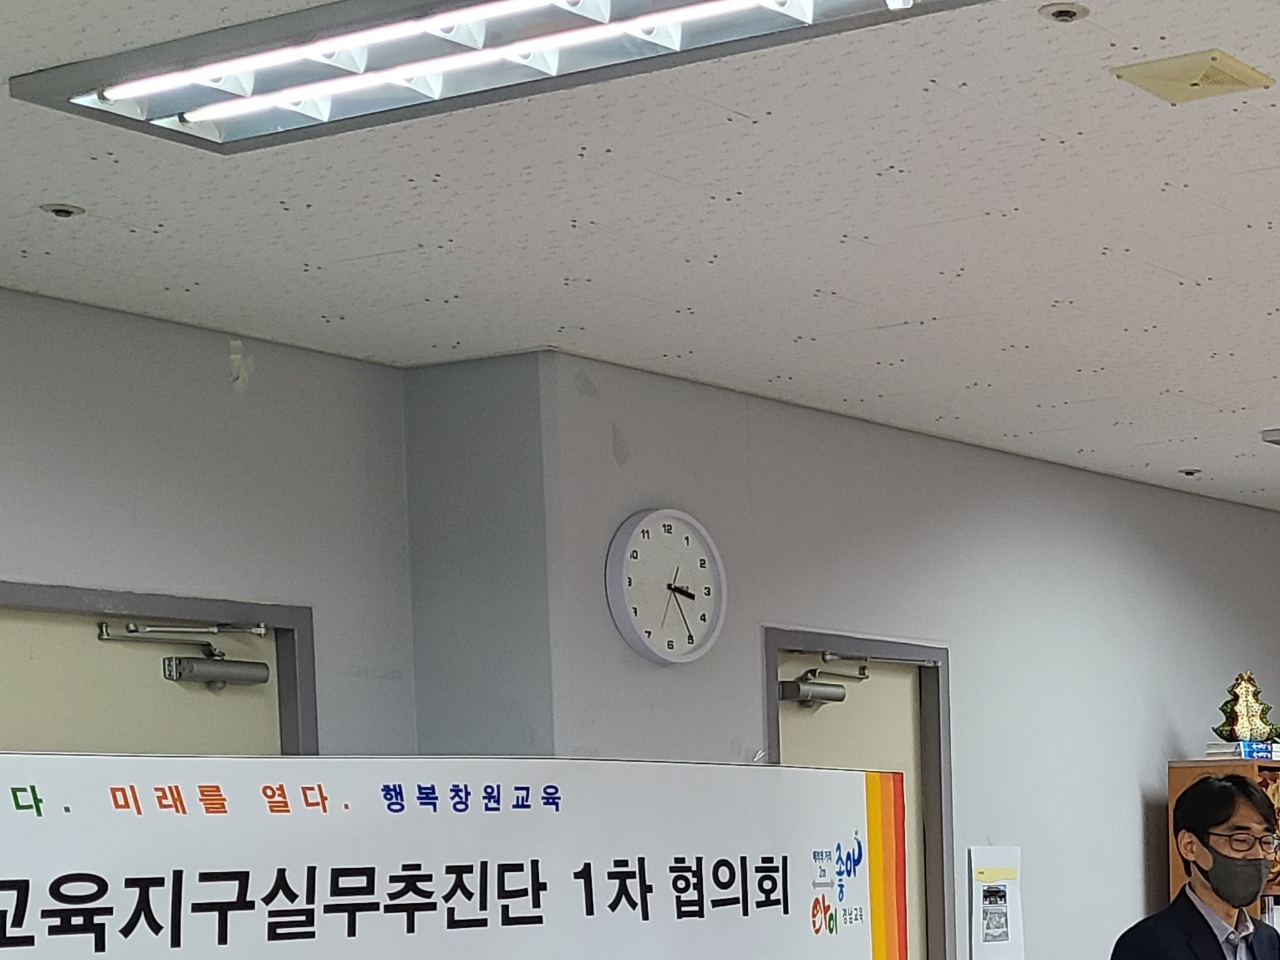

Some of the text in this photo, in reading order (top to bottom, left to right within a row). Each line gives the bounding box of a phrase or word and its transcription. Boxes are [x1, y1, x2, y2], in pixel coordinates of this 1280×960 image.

[662, 524, 673, 534] 12
[641, 529, 650, 540] 11
[684, 536, 690, 546] 1
[699, 559, 706, 568] 2
[704, 587, 711, 596] 3
[700, 613, 707, 622] 4
[644, 630, 652, 639] 7
[667, 640, 674, 649] 6
[109, 784, 228, 816] 미래를
[260, 783, 351, 815] 열다.
[380, 783, 562, 813] 행복창원교육
[573, 856, 654, 921] 1차
[669, 854, 790, 919] 협의회
